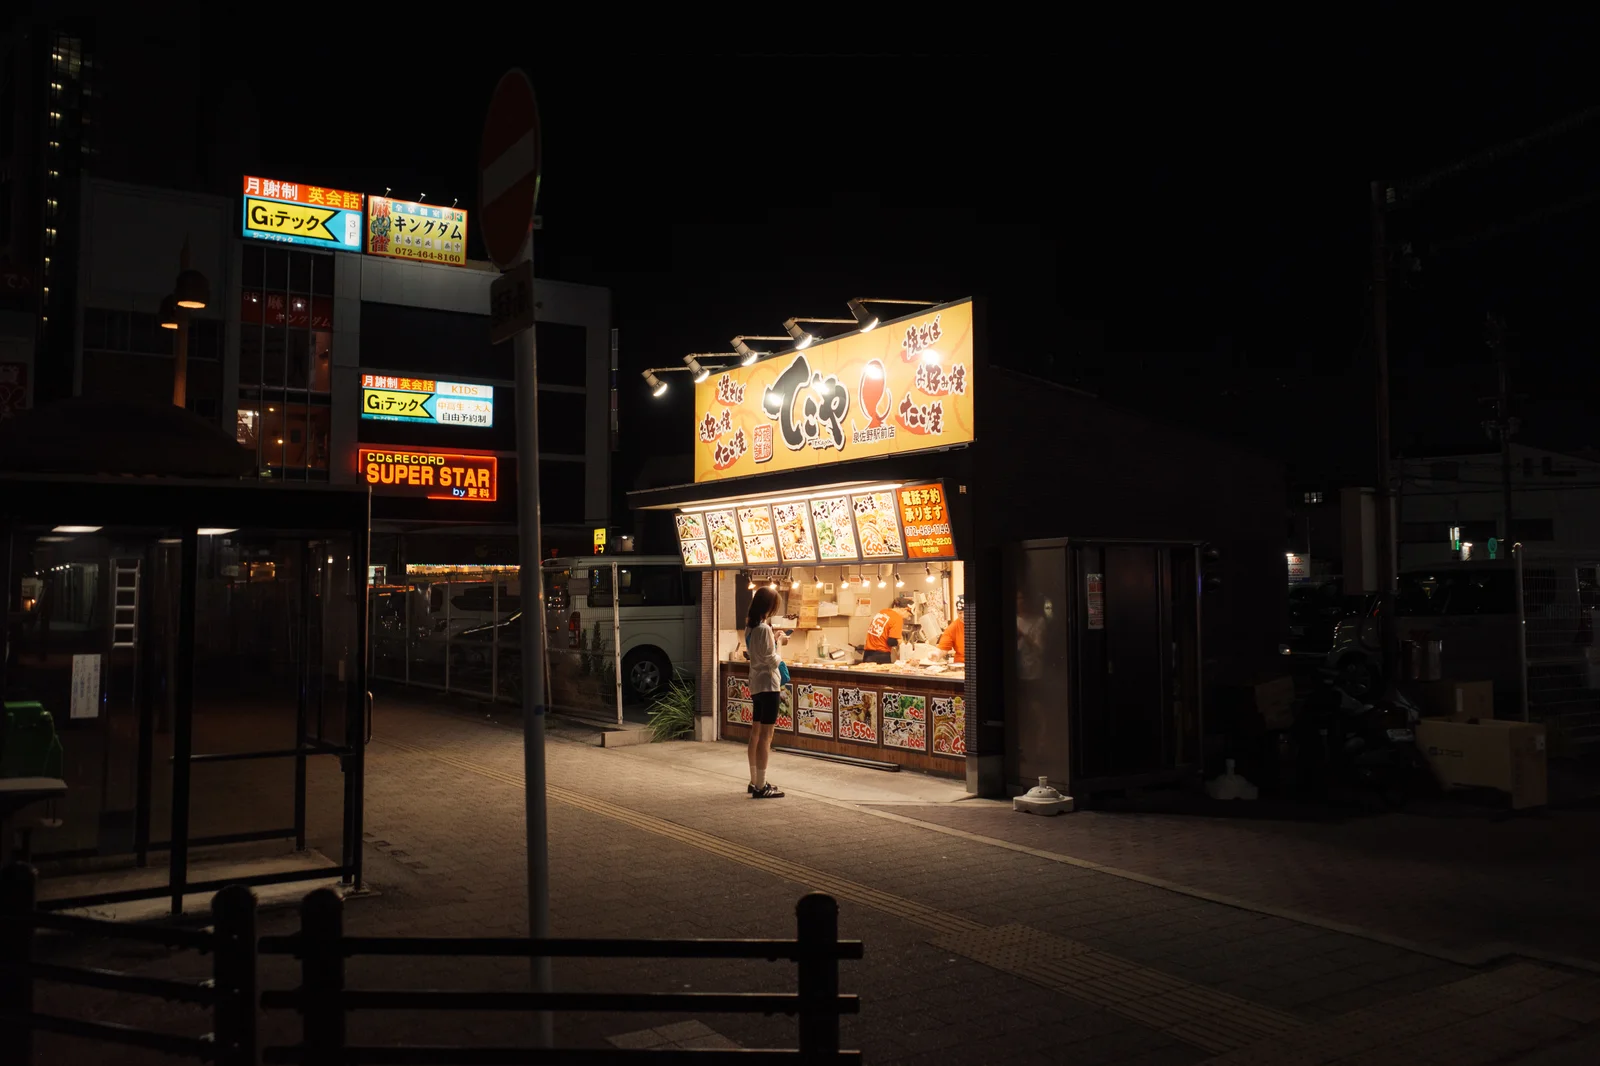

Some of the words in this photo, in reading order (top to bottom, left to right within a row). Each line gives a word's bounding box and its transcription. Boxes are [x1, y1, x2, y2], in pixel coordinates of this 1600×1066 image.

[245, 177, 298, 200] 月謝制
[308, 187, 360, 209] 英会話
[394, 216, 462, 240] キングダム
[395, 247, 460, 263] 072-464-8160
[363, 375, 398, 389] 月謝制
[400, 378, 434, 392] 英会話
[451, 385, 478, 395] KIDS
[442, 412, 487, 423] 自由予約制
[367, 452, 445, 466] CD&RECORD
[366, 463, 434, 485] SUPER
[439, 466, 490, 488] STAR
[452, 487, 466, 497] by
[901, 488, 941, 506] 電話予約
[904, 505, 943, 522] 承ります
